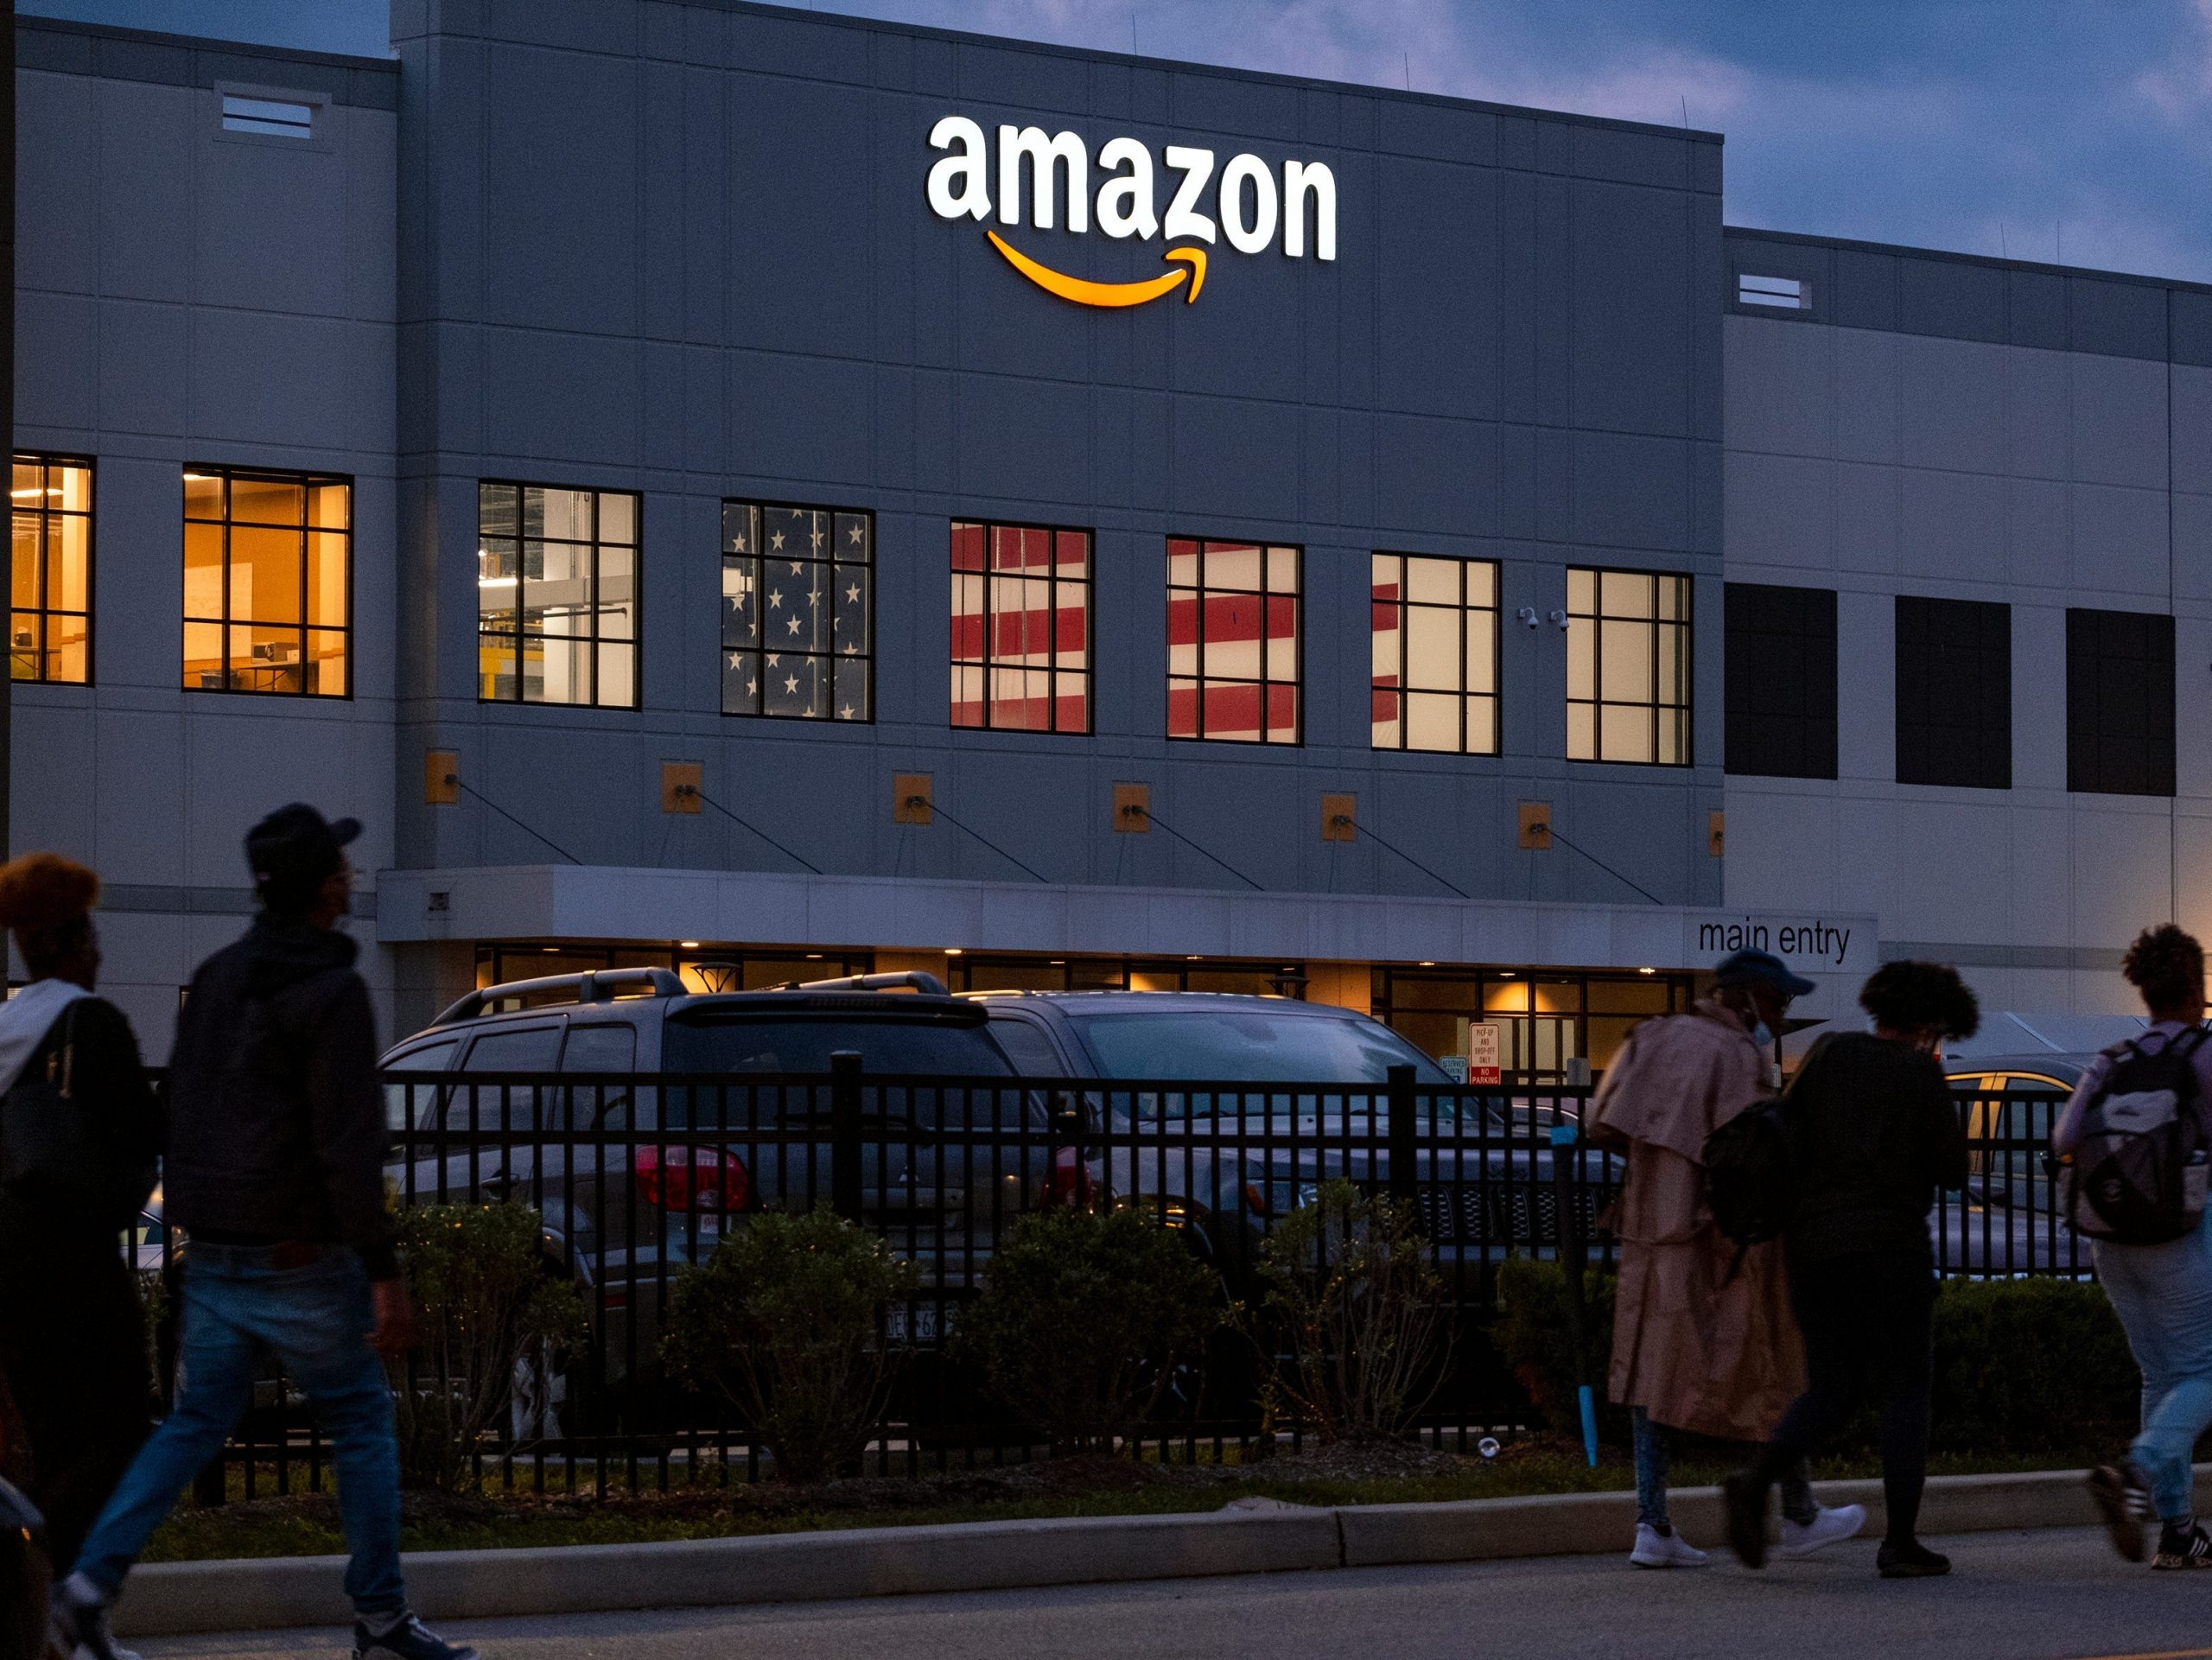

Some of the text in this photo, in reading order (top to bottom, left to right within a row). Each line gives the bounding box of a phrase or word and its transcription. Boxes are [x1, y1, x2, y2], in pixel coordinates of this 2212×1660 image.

[925, 116, 1337, 262] amazon
[1700, 916, 1850, 965] main entry
[1471, 1076, 1498, 1084] PARKING
